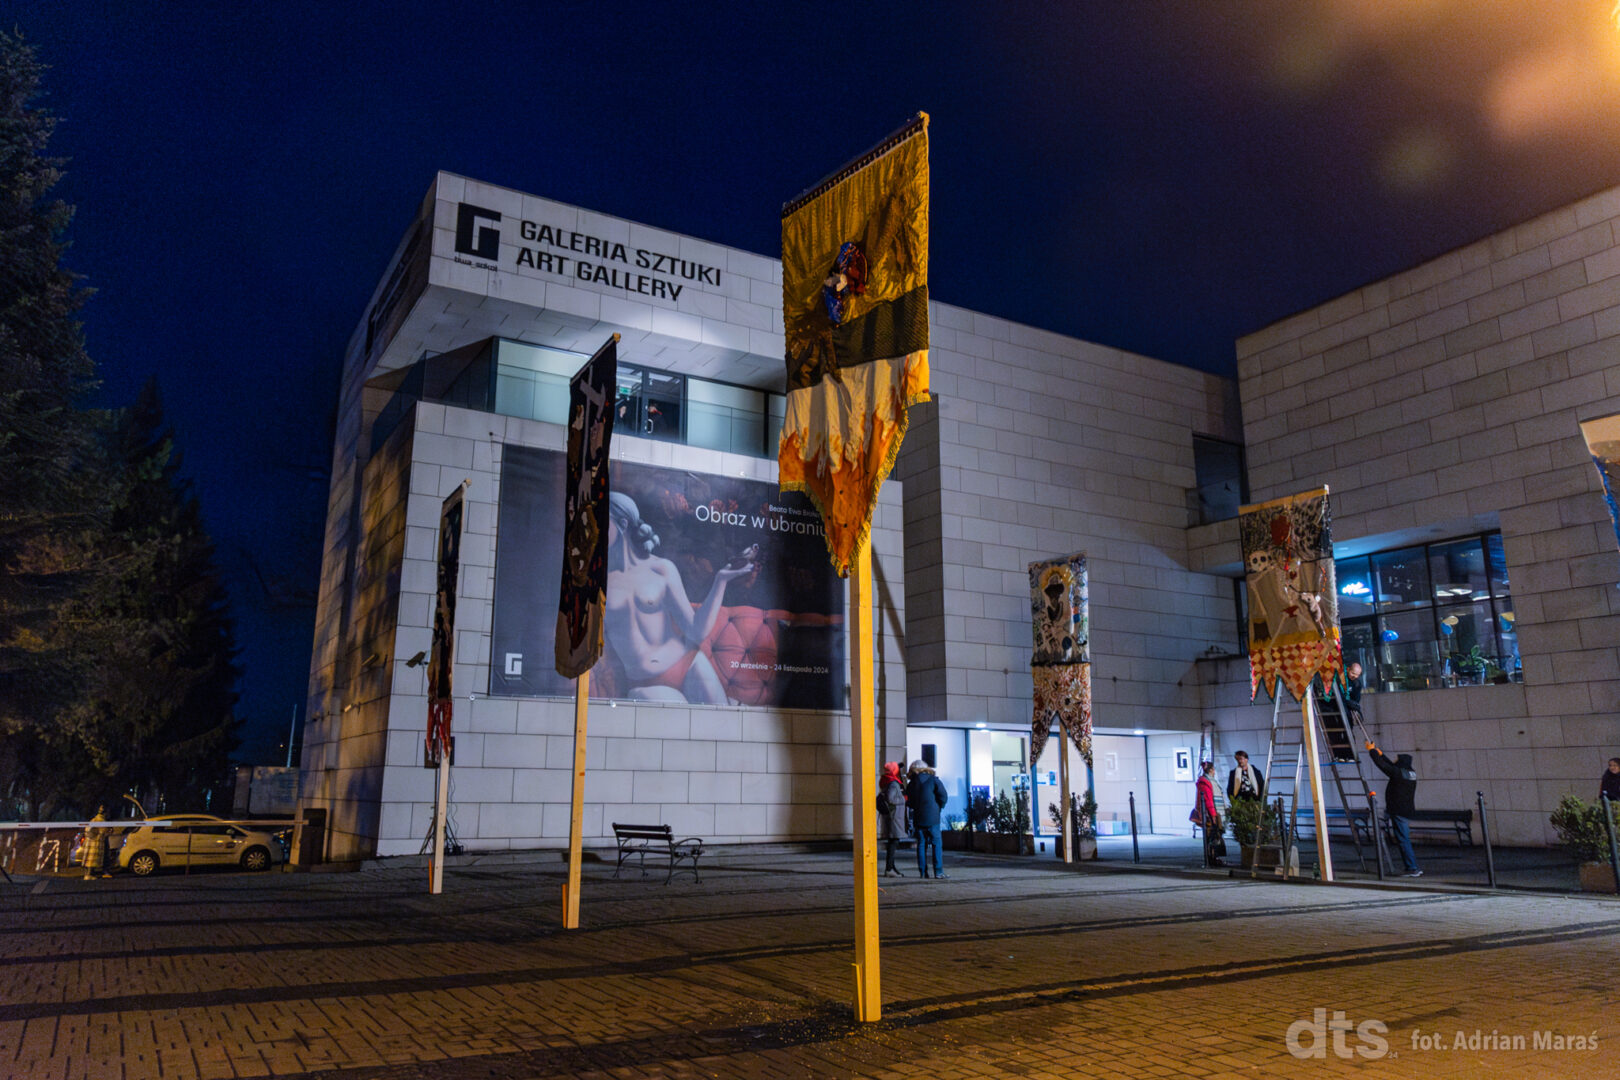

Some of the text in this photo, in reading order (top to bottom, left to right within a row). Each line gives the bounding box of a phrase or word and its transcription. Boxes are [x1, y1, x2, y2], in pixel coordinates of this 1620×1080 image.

[520, 220, 721, 286] GALERIA SZTUKI
[516, 247, 683, 301] ART GALLERY
[695, 505, 747, 527] Obraz
[751, 516, 765, 529] w
[768, 504, 788, 514] Beata
[730, 660, 740, 668] 20
[774, 663, 783, 671] 24
